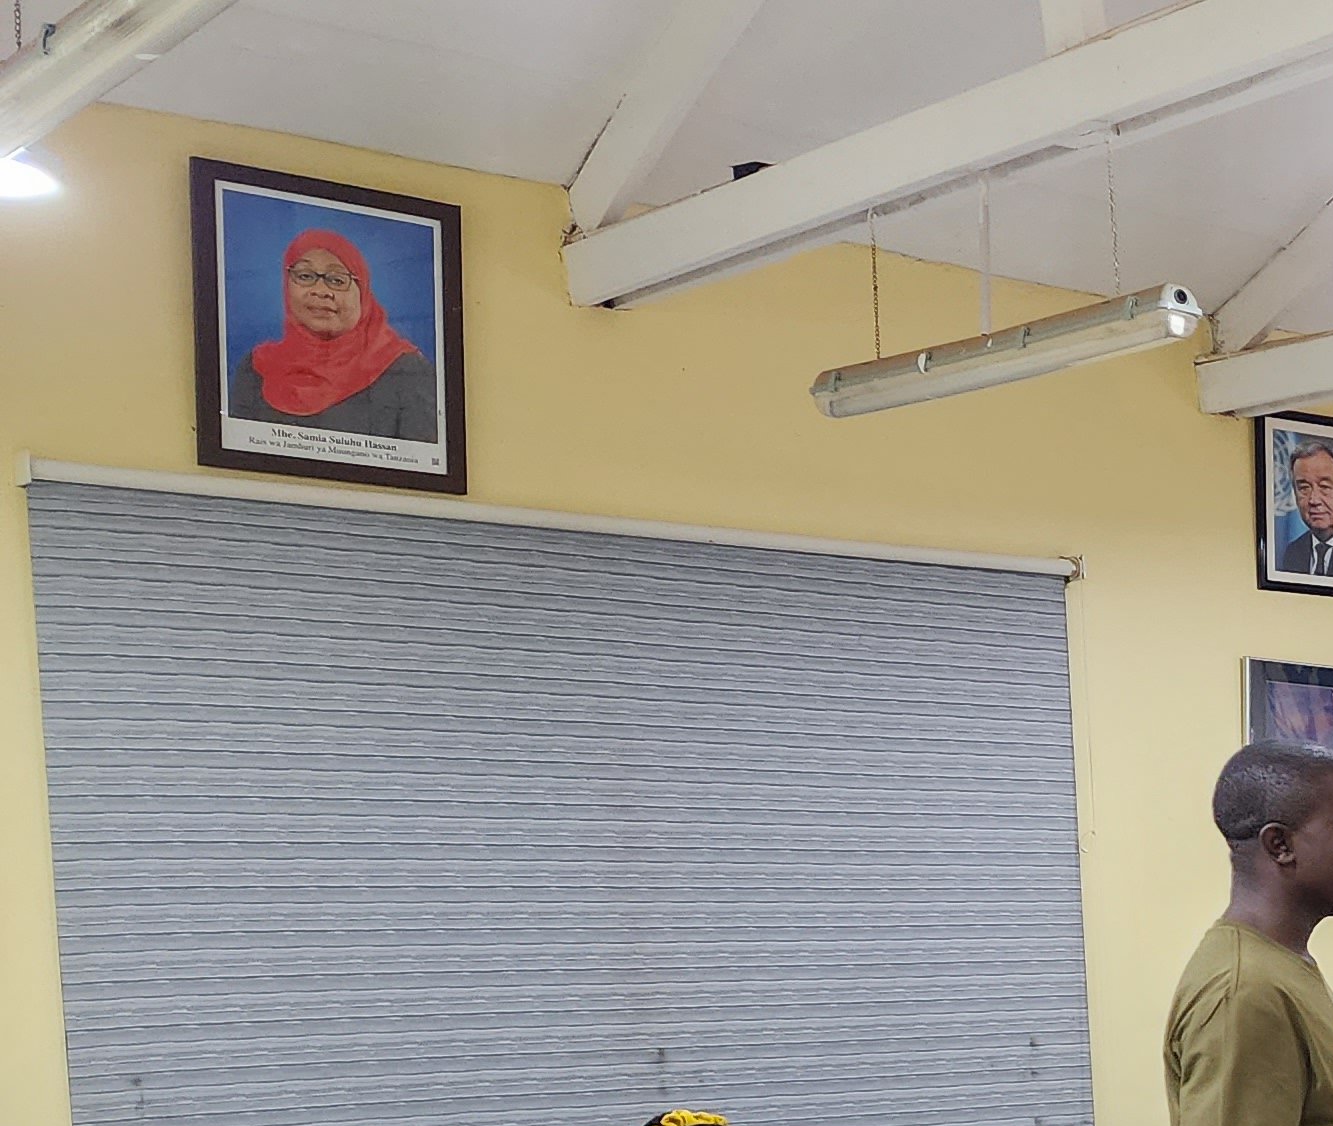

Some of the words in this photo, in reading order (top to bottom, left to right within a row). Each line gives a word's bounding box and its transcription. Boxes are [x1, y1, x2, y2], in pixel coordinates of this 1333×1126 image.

[298, 432, 327, 443] Samia
[329, 435, 362, 447] Suluhu
[365, 440, 397, 451] Hassan
